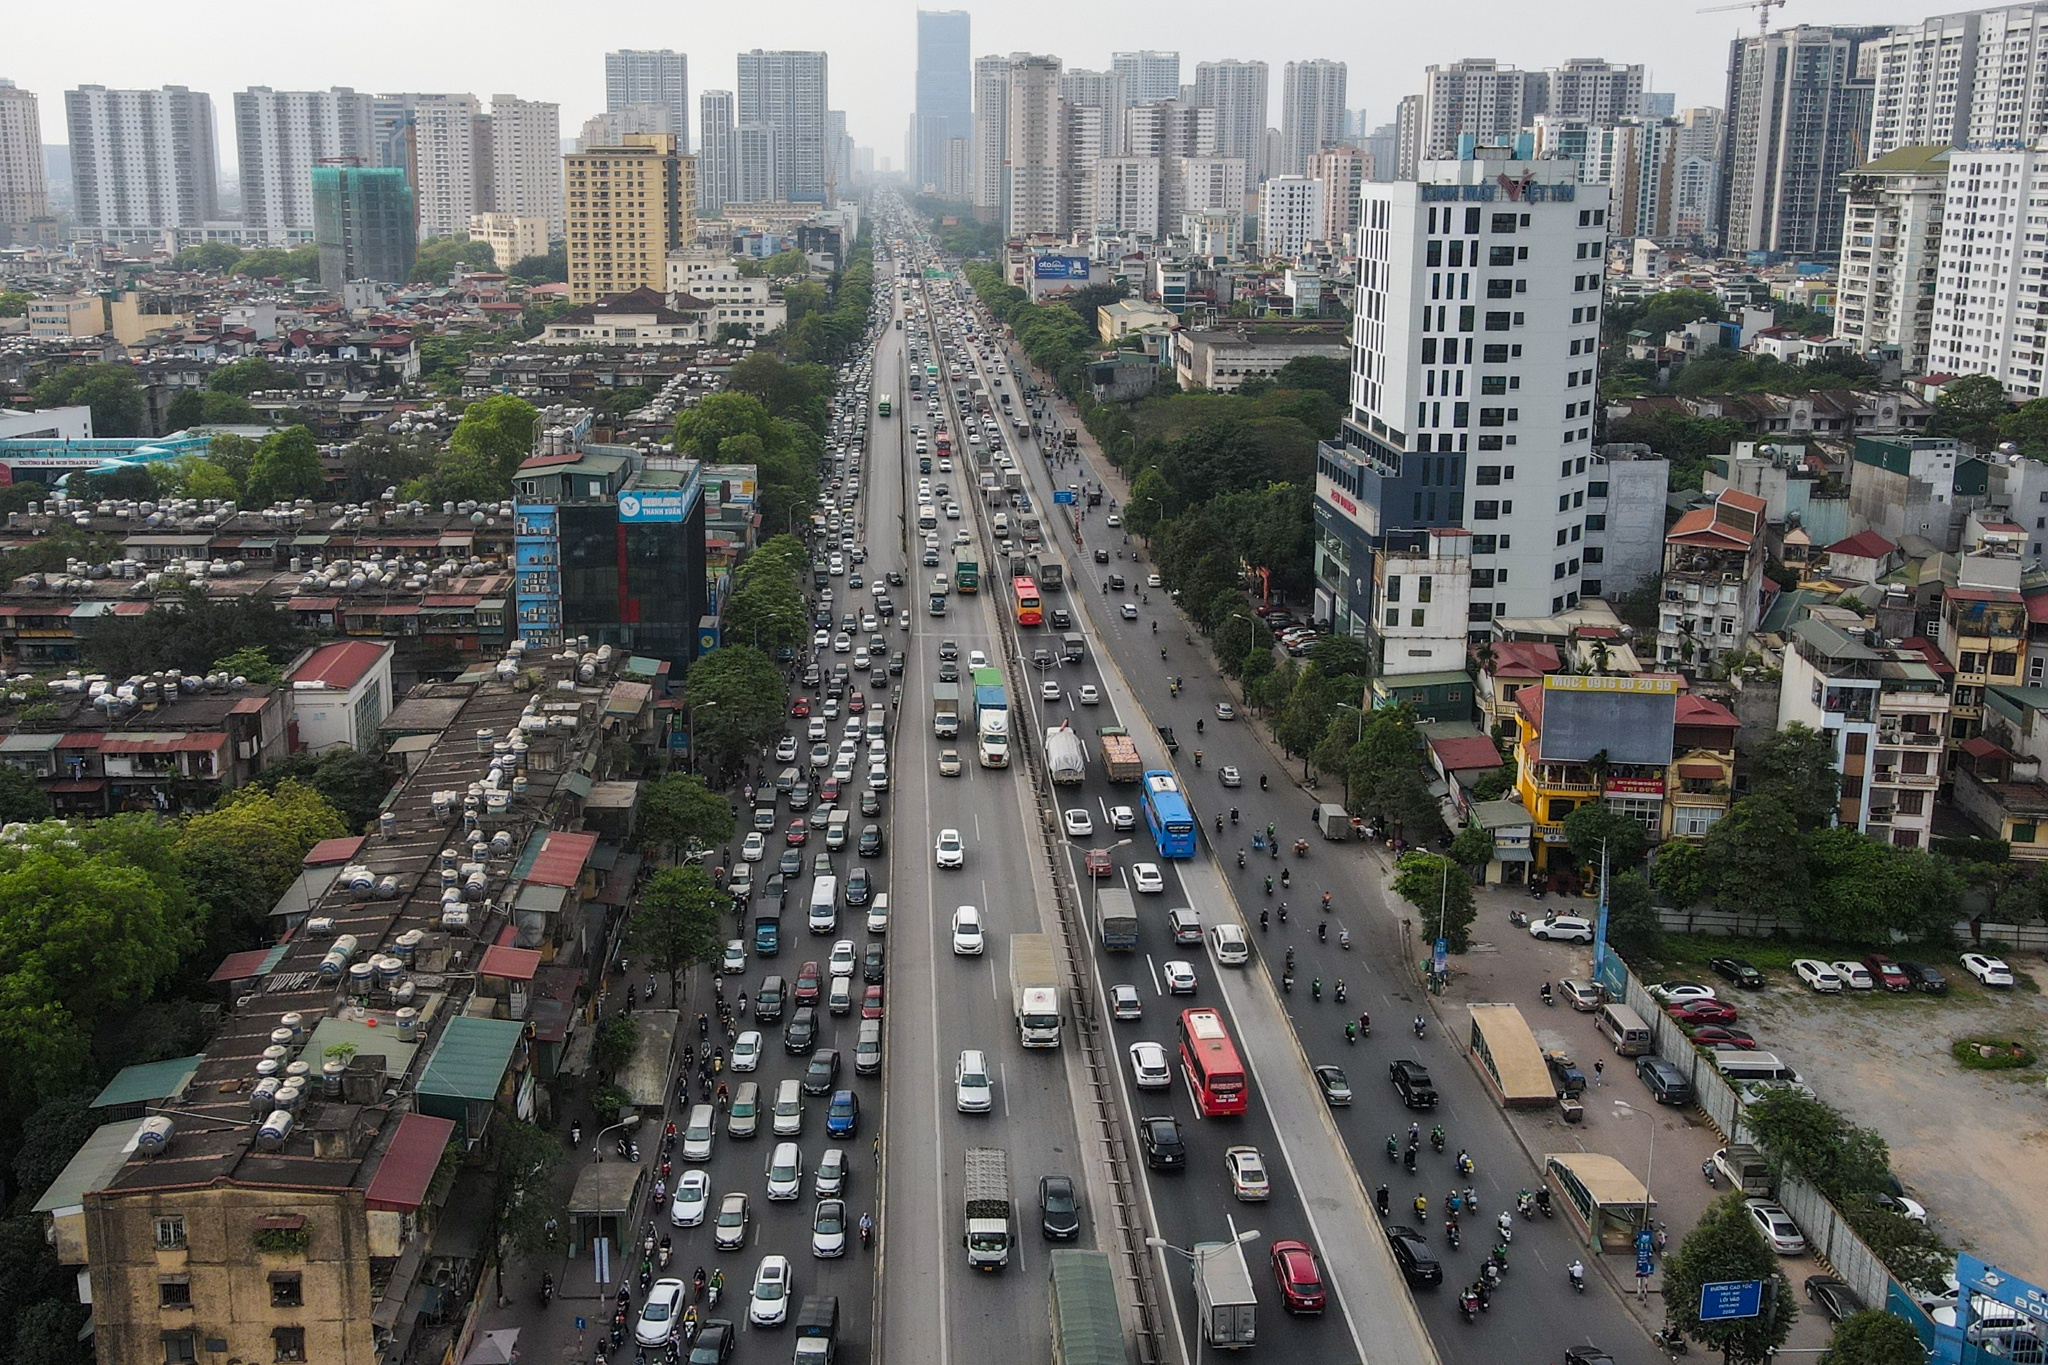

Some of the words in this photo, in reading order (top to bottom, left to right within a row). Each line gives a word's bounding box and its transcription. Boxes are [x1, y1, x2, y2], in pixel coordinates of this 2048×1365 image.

[642, 507, 664, 516] THANH
[664, 507, 682, 516] XUÂN
[1552, 676, 1583, 688] MQC:
[1586, 678, 1616, 690] 0916
[1619, 679, 1635, 690] 80
[1637, 680, 1653, 691] 20
[1656, 681, 1672, 691] 99
